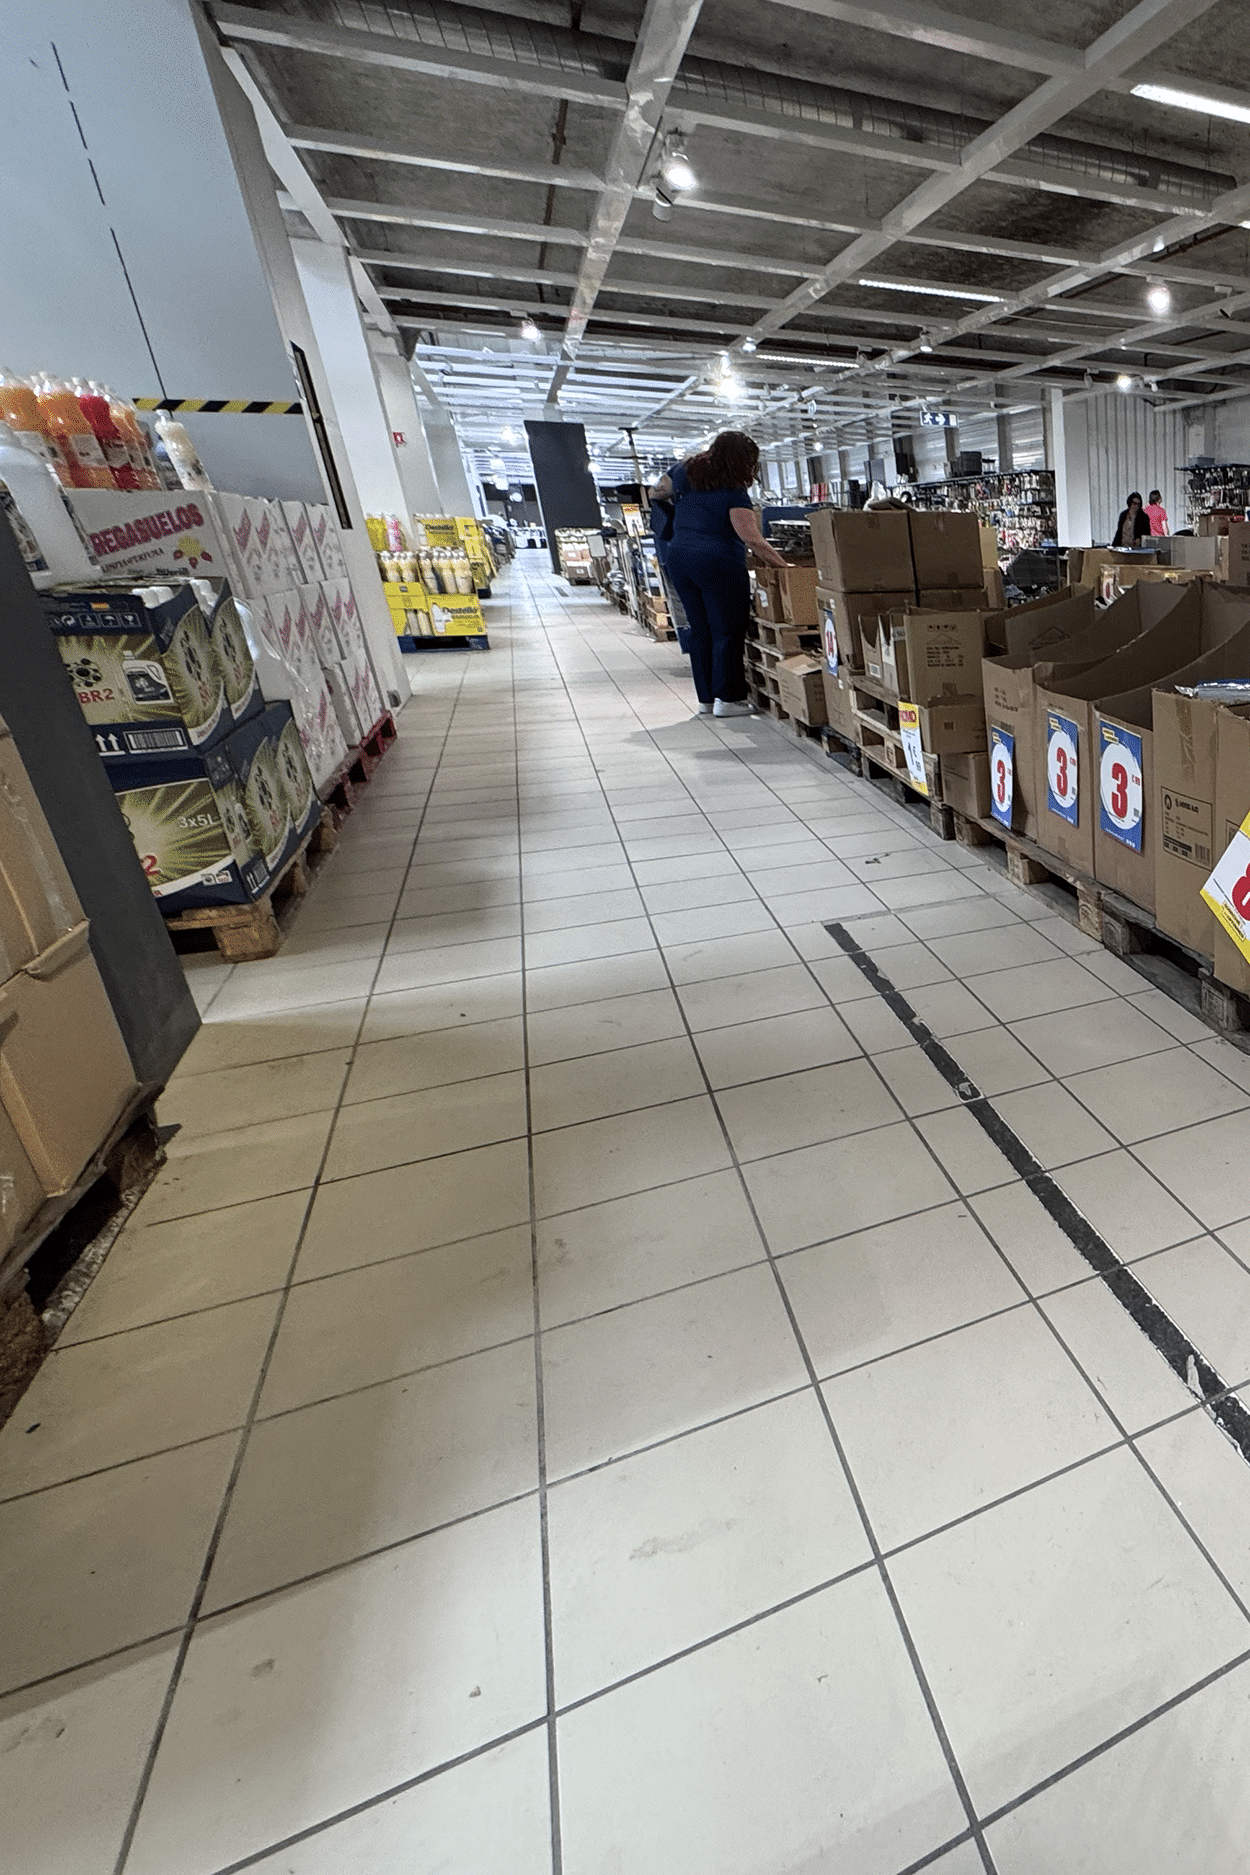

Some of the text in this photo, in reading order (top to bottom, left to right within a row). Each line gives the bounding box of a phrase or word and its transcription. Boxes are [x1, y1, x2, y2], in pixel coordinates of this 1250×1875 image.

[997, 759, 1006, 804] 3
[1056, 747, 1068, 797] 3
[1112, 762, 1128, 818] 3
[178, 813, 220, 829] 3x5L
